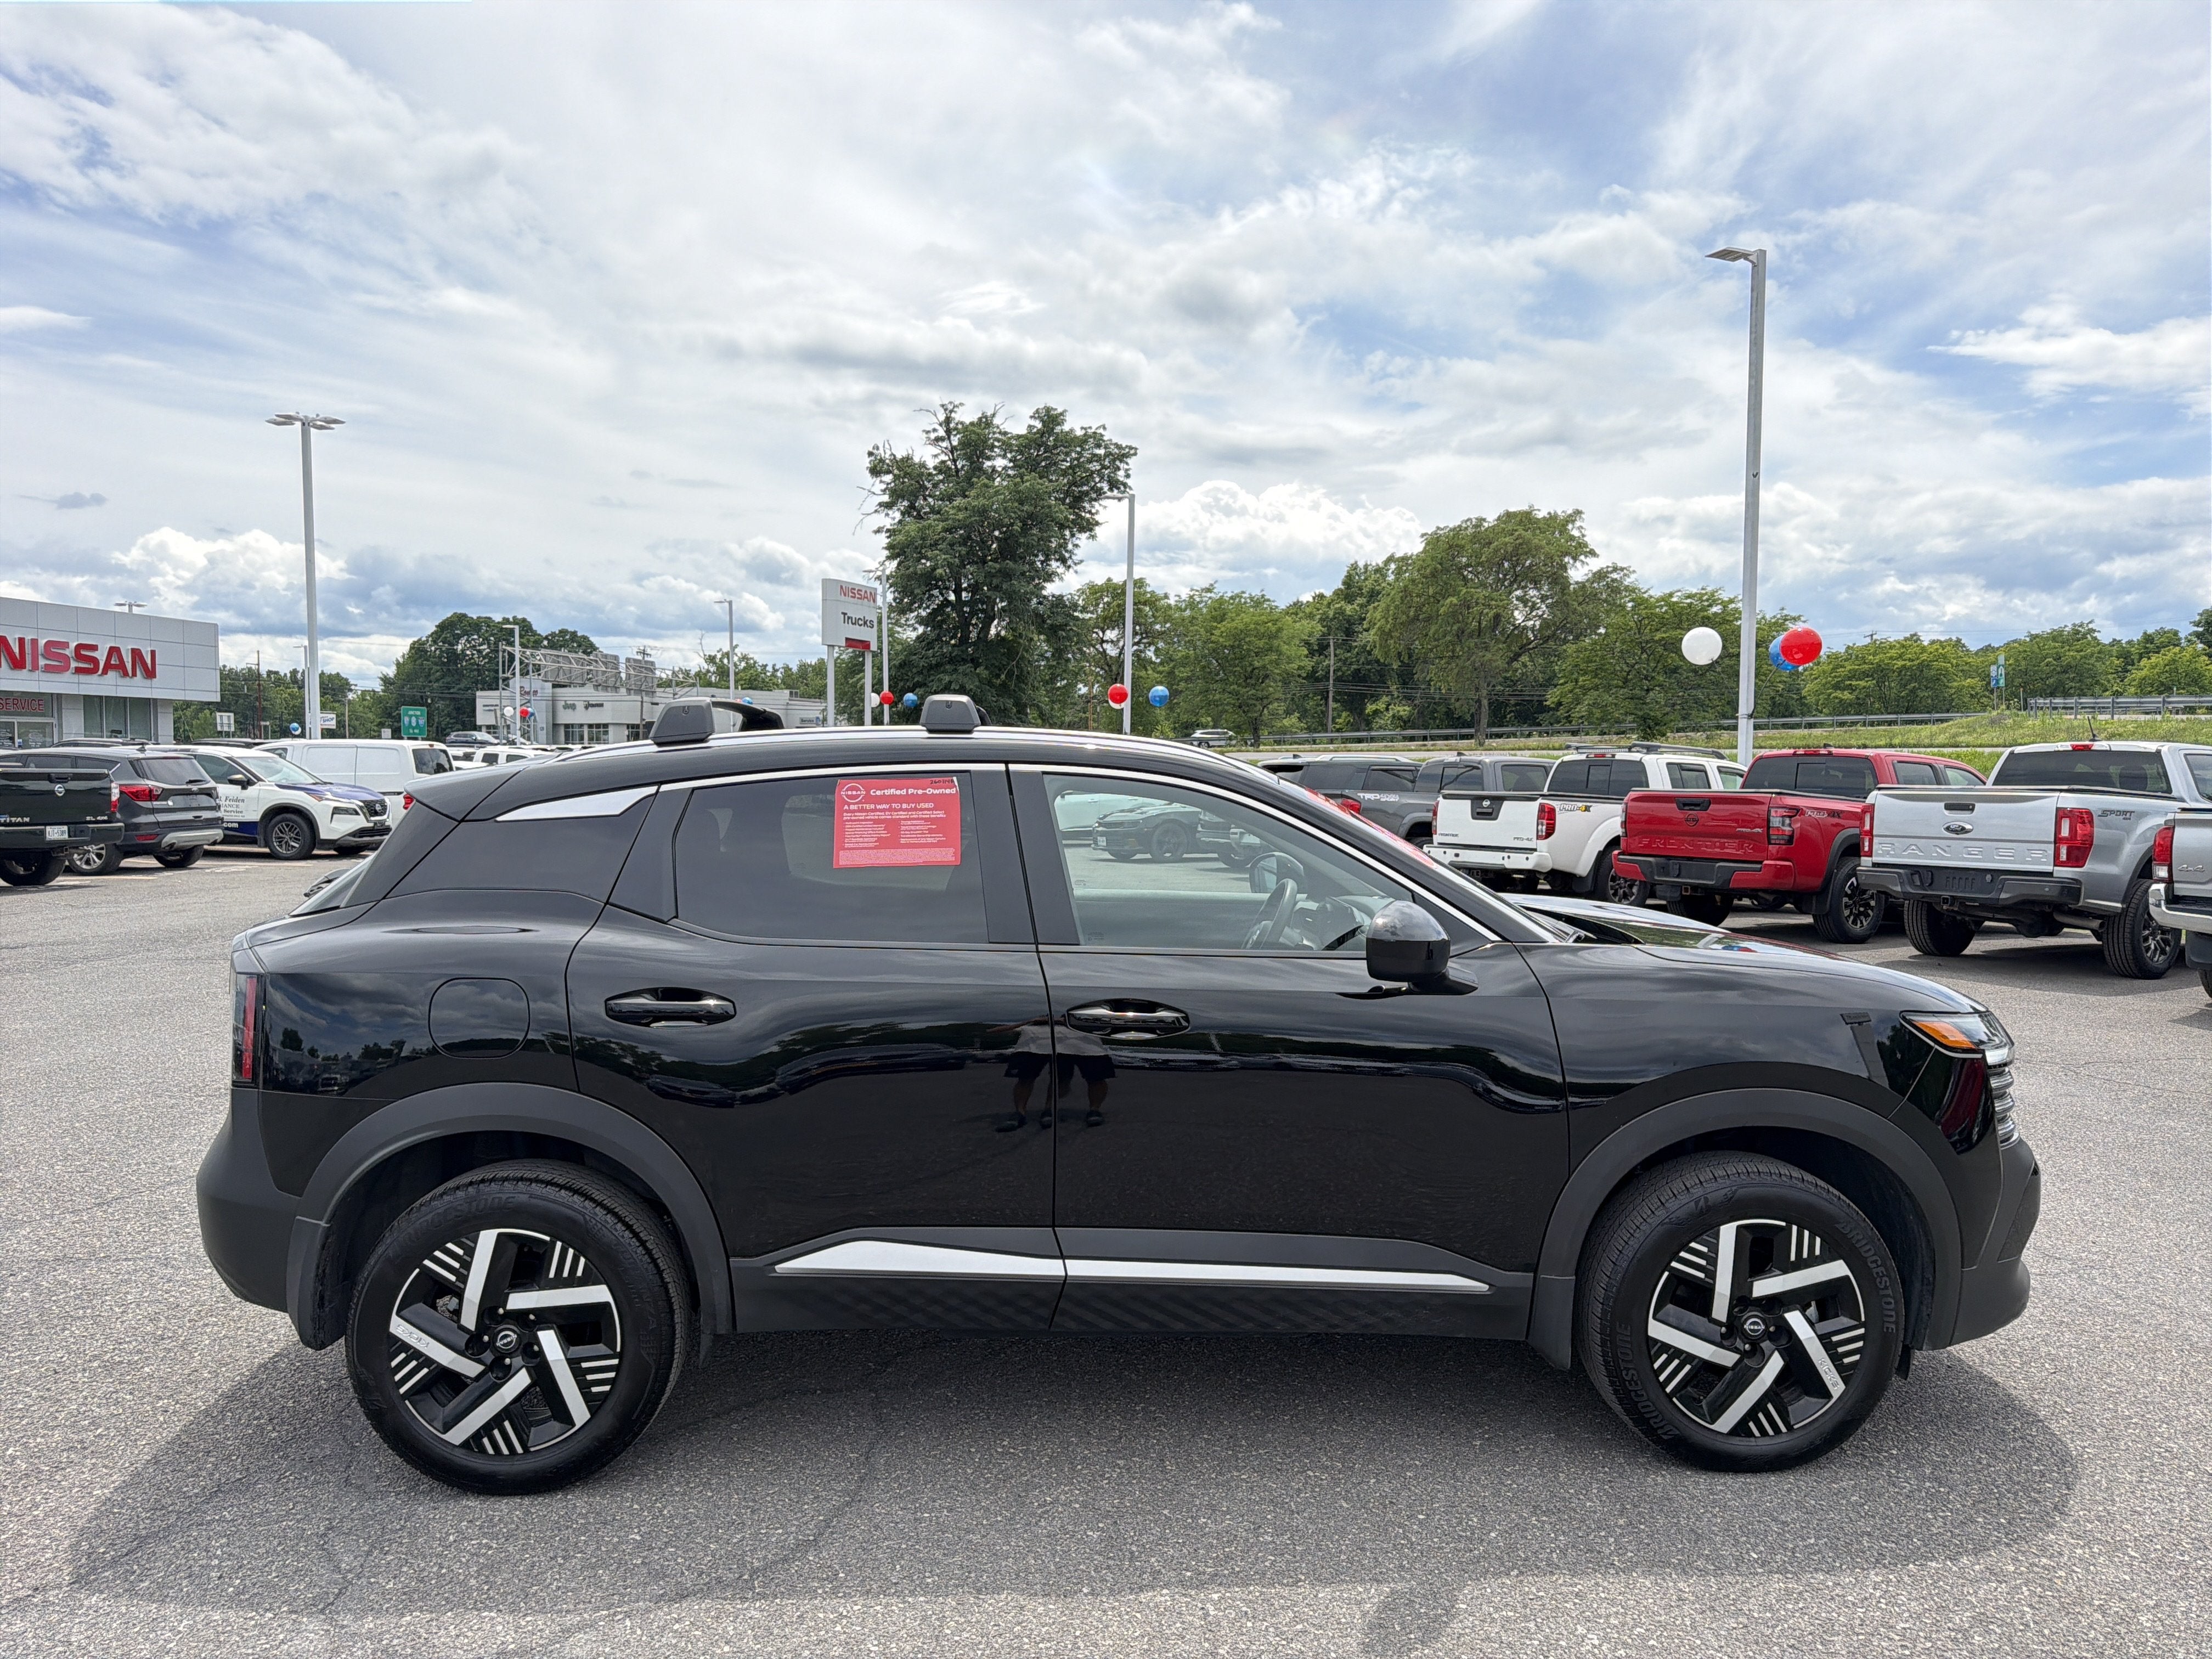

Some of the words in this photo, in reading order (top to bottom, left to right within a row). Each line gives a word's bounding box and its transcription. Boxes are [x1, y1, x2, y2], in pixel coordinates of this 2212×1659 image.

[840, 585, 876, 603] NISSAN
[841, 612, 874, 629] Trucks
[0, 635, 157, 679] NISSAN
[0, 697, 44, 711] SERVICE
[1560, 804, 1593, 812] PRO-4X
[1638, 838, 1754, 853] FRONTIER
[1877, 843, 2048, 861] RANGER
[1838, 1219, 1896, 1334] BRIDGESTONE
[1616, 1321, 1680, 1440] BRIDGESTONE
[1818, 1358, 1840, 1390] KICKS
